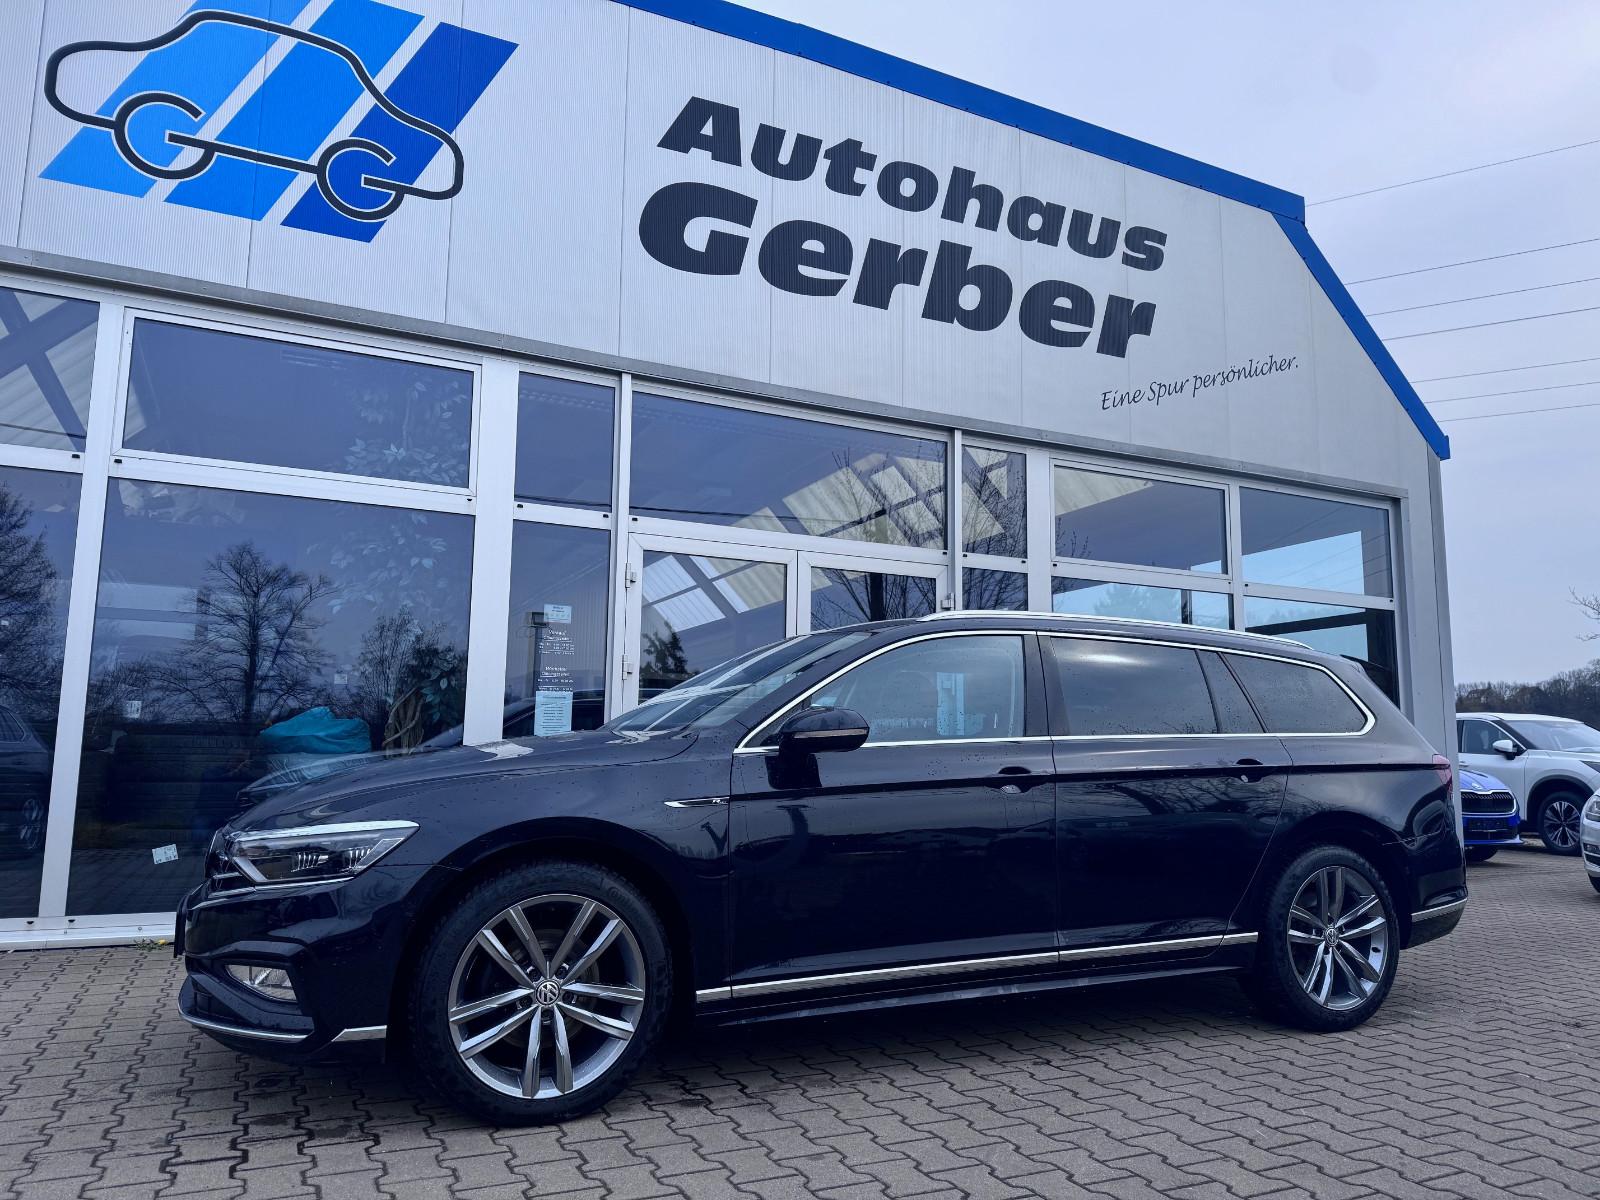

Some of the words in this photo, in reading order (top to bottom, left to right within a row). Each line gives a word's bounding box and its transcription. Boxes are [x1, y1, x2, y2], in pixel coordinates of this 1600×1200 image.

[638, 182, 1158, 359] Gerber
[656, 95, 1168, 272] Autohaus
[1100, 389, 1146, 411] Eine
[1147, 380, 1190, 406] Spur
[1191, 353, 1299, 398] persönlicher.
